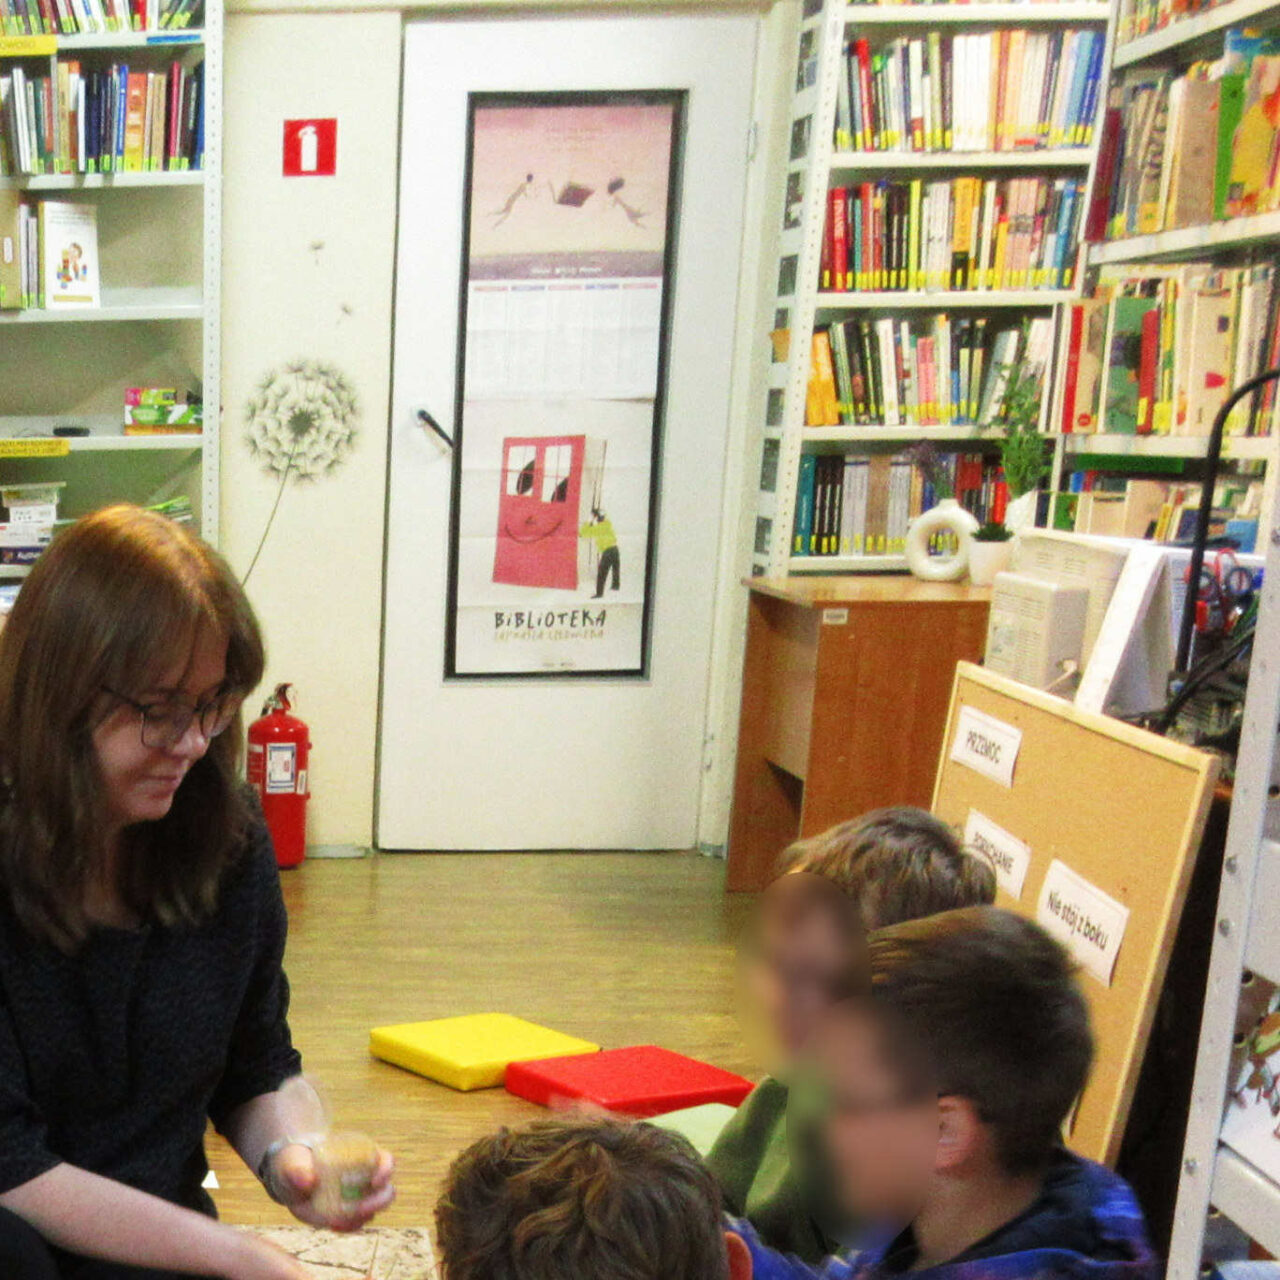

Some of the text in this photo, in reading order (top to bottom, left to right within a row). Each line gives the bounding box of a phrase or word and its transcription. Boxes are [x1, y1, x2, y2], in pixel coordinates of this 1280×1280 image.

[1048, 890, 1061, 915] Nie
[1061, 904, 1079, 936] stój
[1083, 917, 1108, 950] boku
